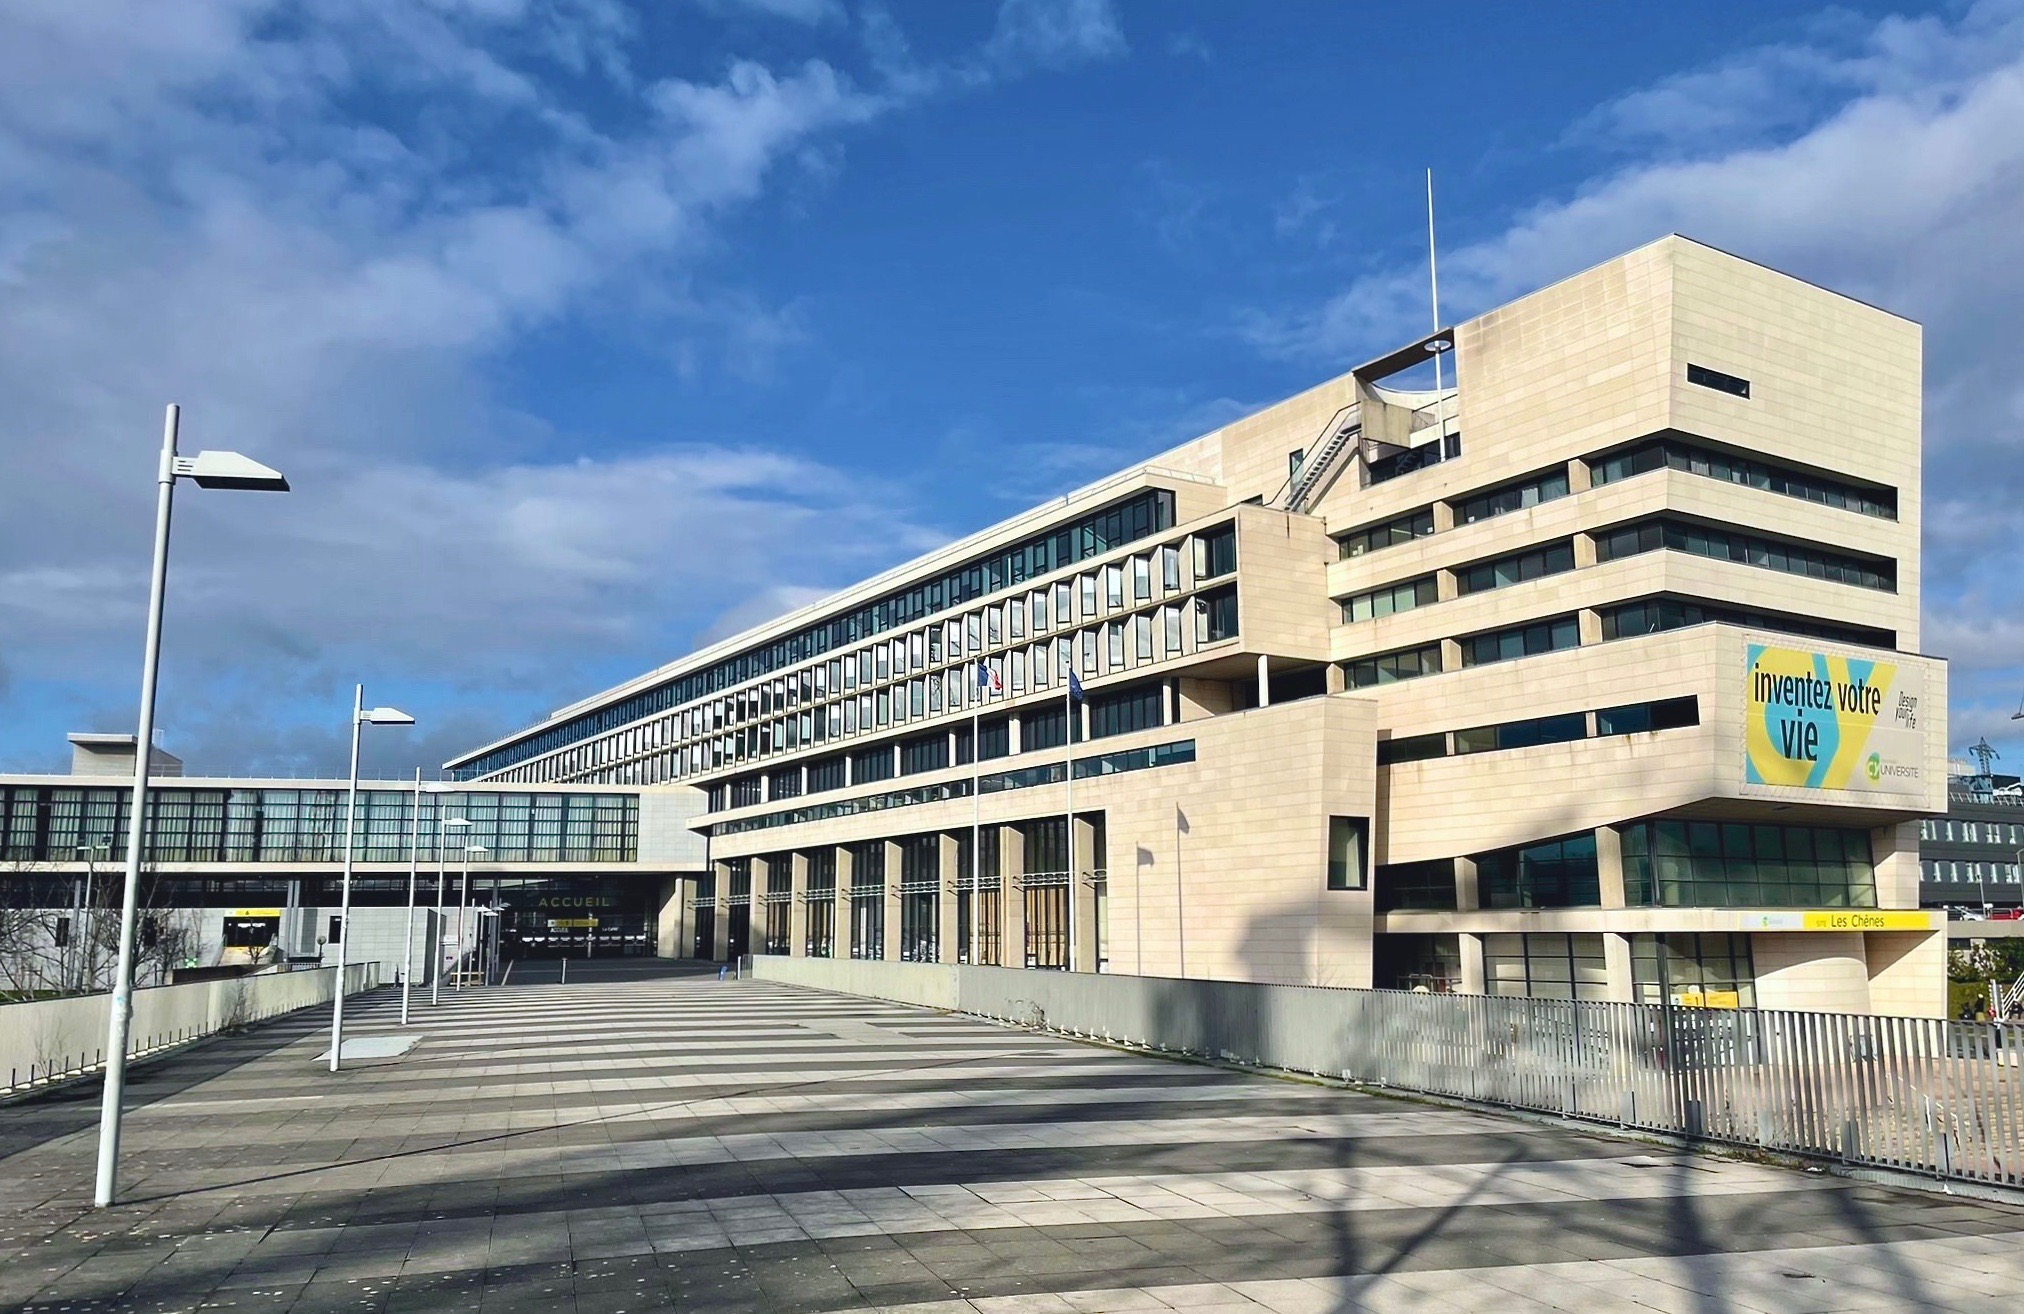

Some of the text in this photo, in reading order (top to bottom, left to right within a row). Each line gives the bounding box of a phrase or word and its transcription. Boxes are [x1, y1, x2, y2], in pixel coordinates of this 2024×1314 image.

[1754, 662, 1881, 715] inventez votre
[1898, 691, 1918, 713] Design
[1780, 708, 1818, 761] vie
[539, 897, 610, 907] ACCUEIL
[1831, 914, 1847, 928] Les
